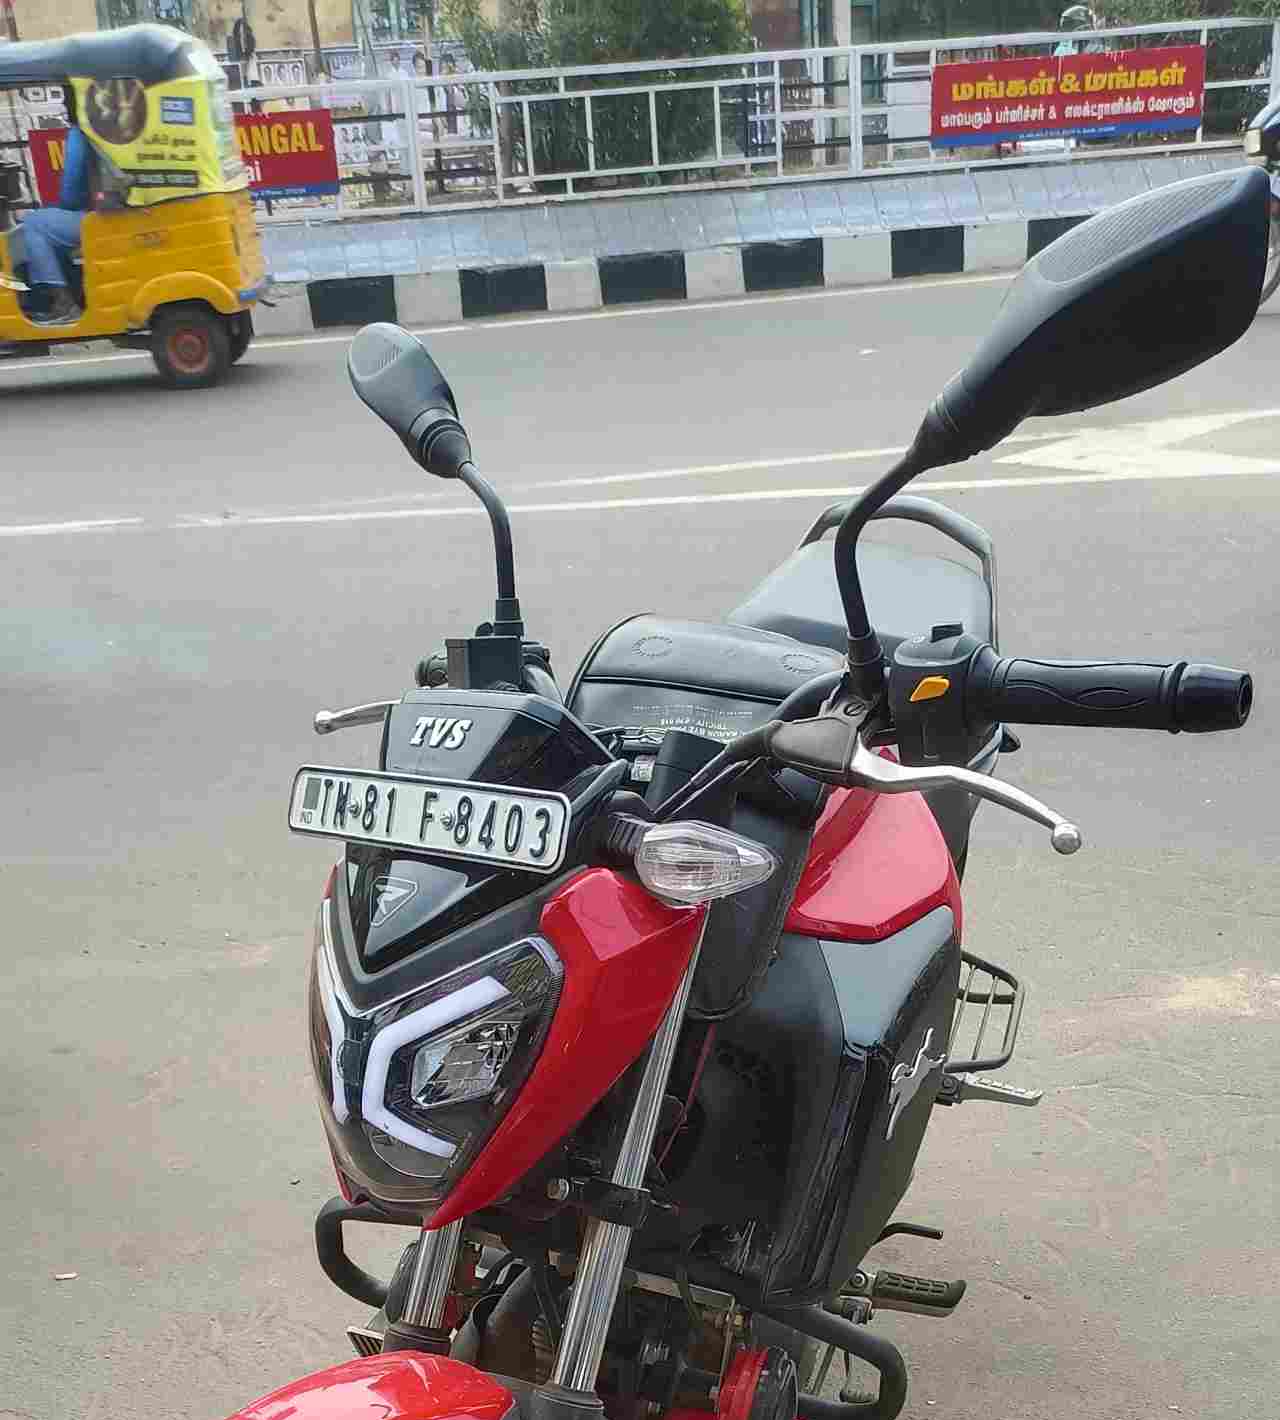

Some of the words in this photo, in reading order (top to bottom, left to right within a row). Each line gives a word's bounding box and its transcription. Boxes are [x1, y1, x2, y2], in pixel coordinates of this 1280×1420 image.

[951, 71, 1056, 102] மங்கள்
[1060, 73, 1081, 93] &
[1084, 61, 1187, 92] மங்கள்
[236, 120, 325, 156] ANGAL
[409, 716, 472, 750] TVS
[320, 778, 351, 829] TN
[362, 784, 397, 833] 81
[419, 790, 440, 842] F
[453, 795, 553, 859] 8403
